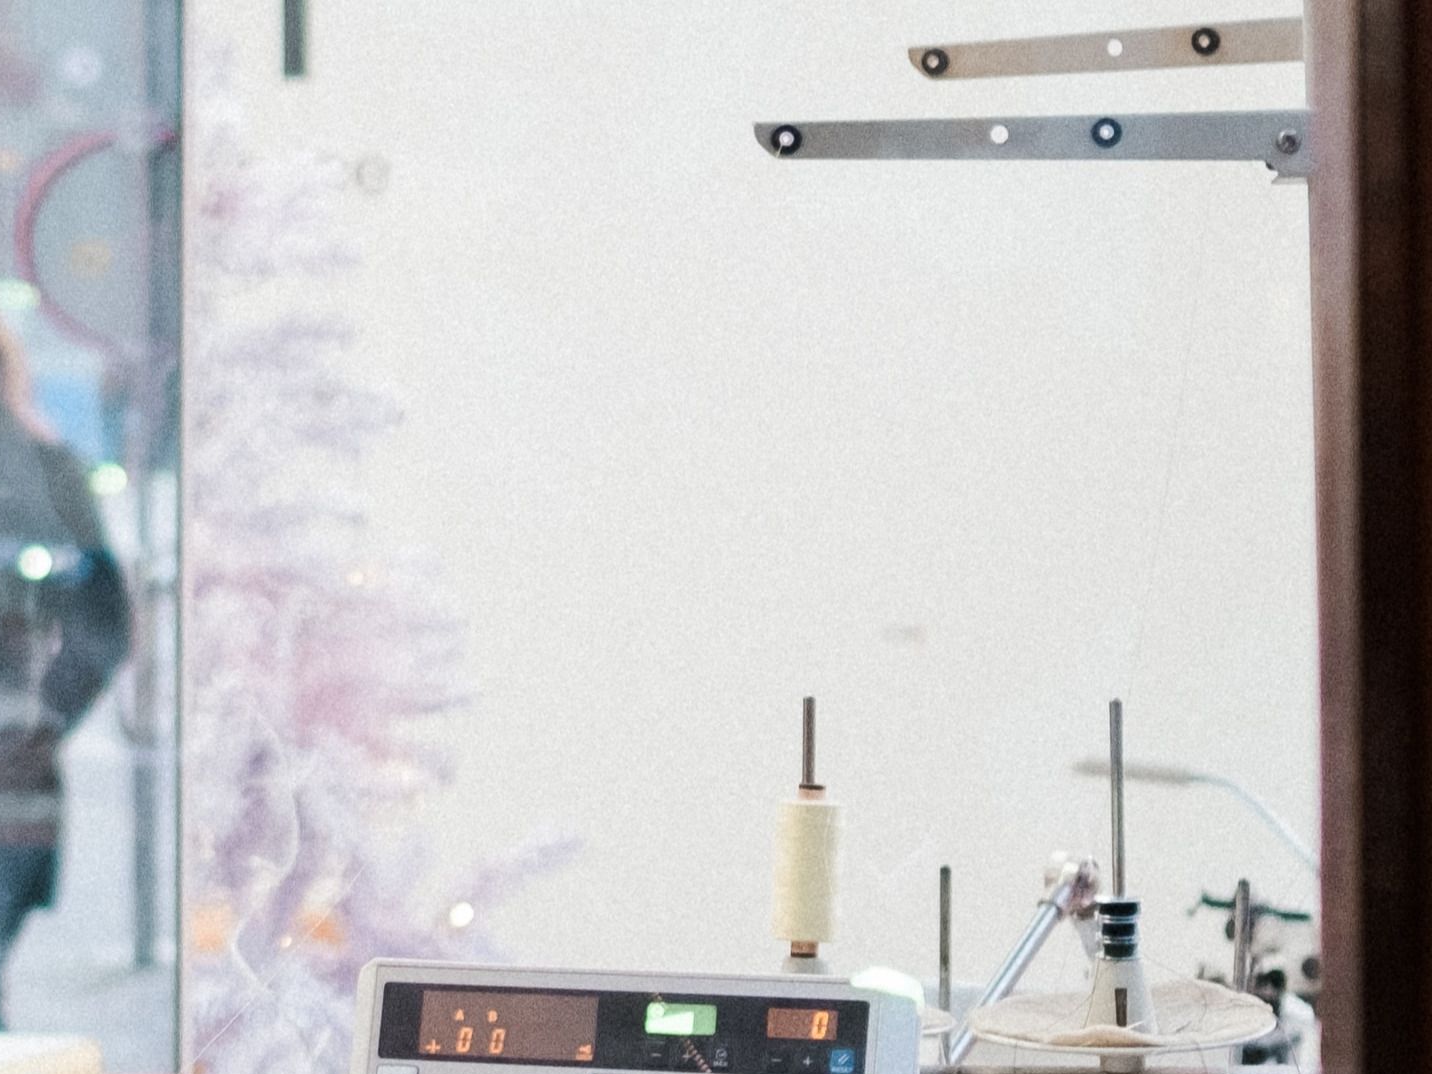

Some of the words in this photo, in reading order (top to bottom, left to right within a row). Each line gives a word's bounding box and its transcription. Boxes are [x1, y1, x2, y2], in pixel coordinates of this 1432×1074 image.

[811, 1010, 829, 1040] 0
[456, 1027, 473, 1053] 0
[489, 1028, 506, 1055] 0
